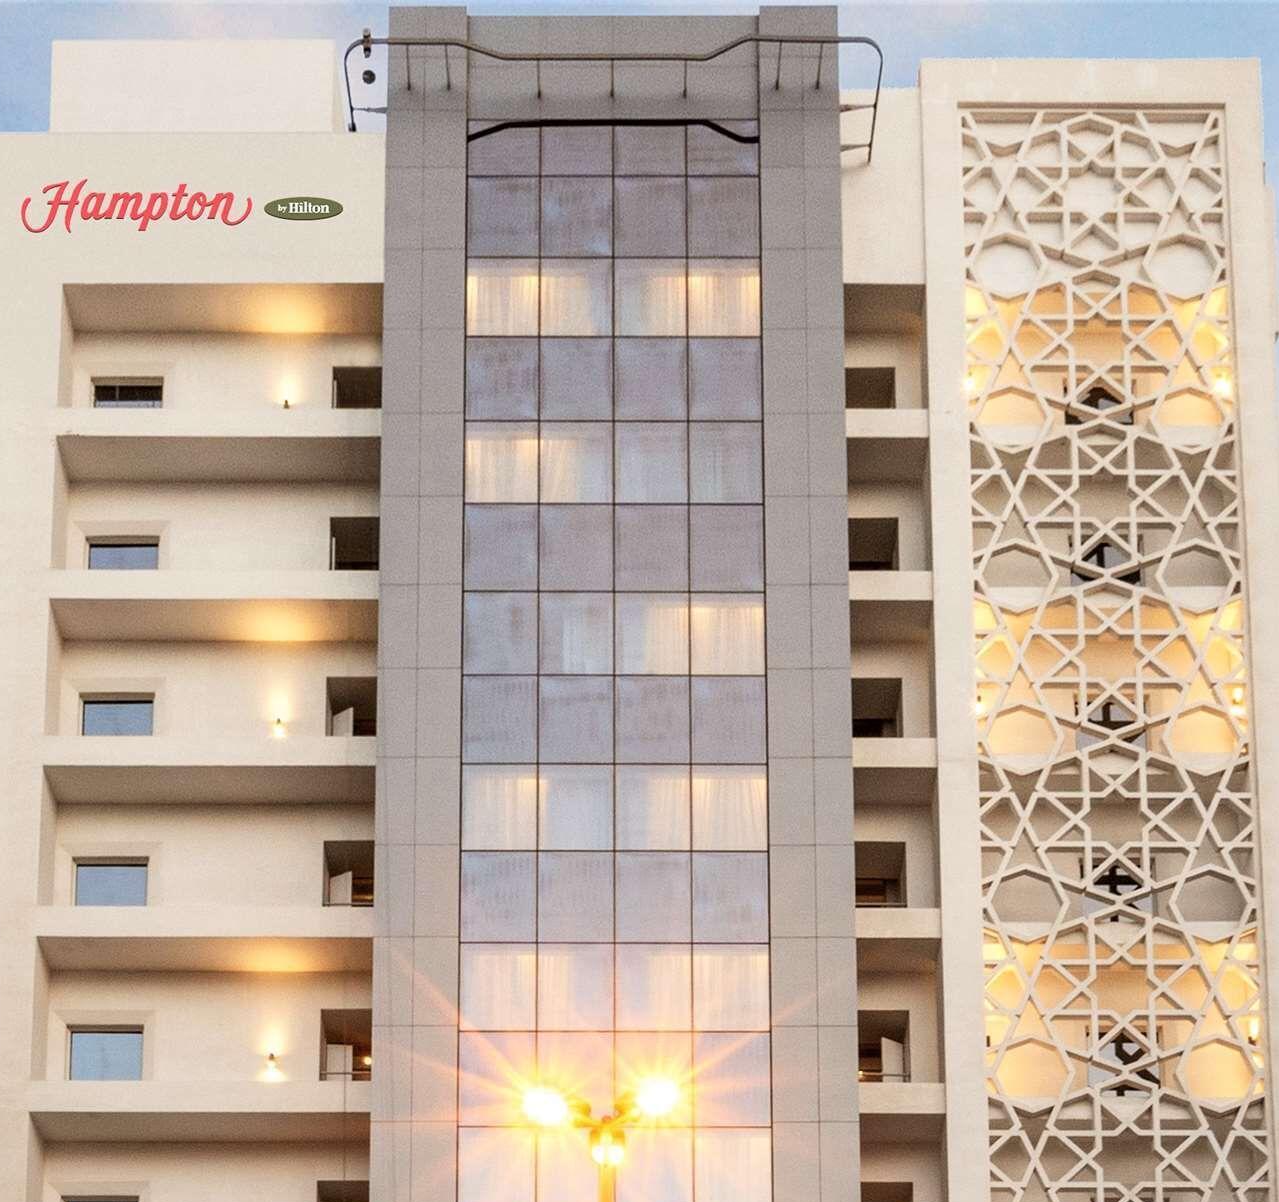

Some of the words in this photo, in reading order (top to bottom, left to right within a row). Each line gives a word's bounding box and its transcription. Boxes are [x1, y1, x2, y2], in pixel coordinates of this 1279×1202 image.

[21, 178, 252, 233] Hampton
[277, 204, 287, 213] by
[288, 201, 330, 215] Hilton
